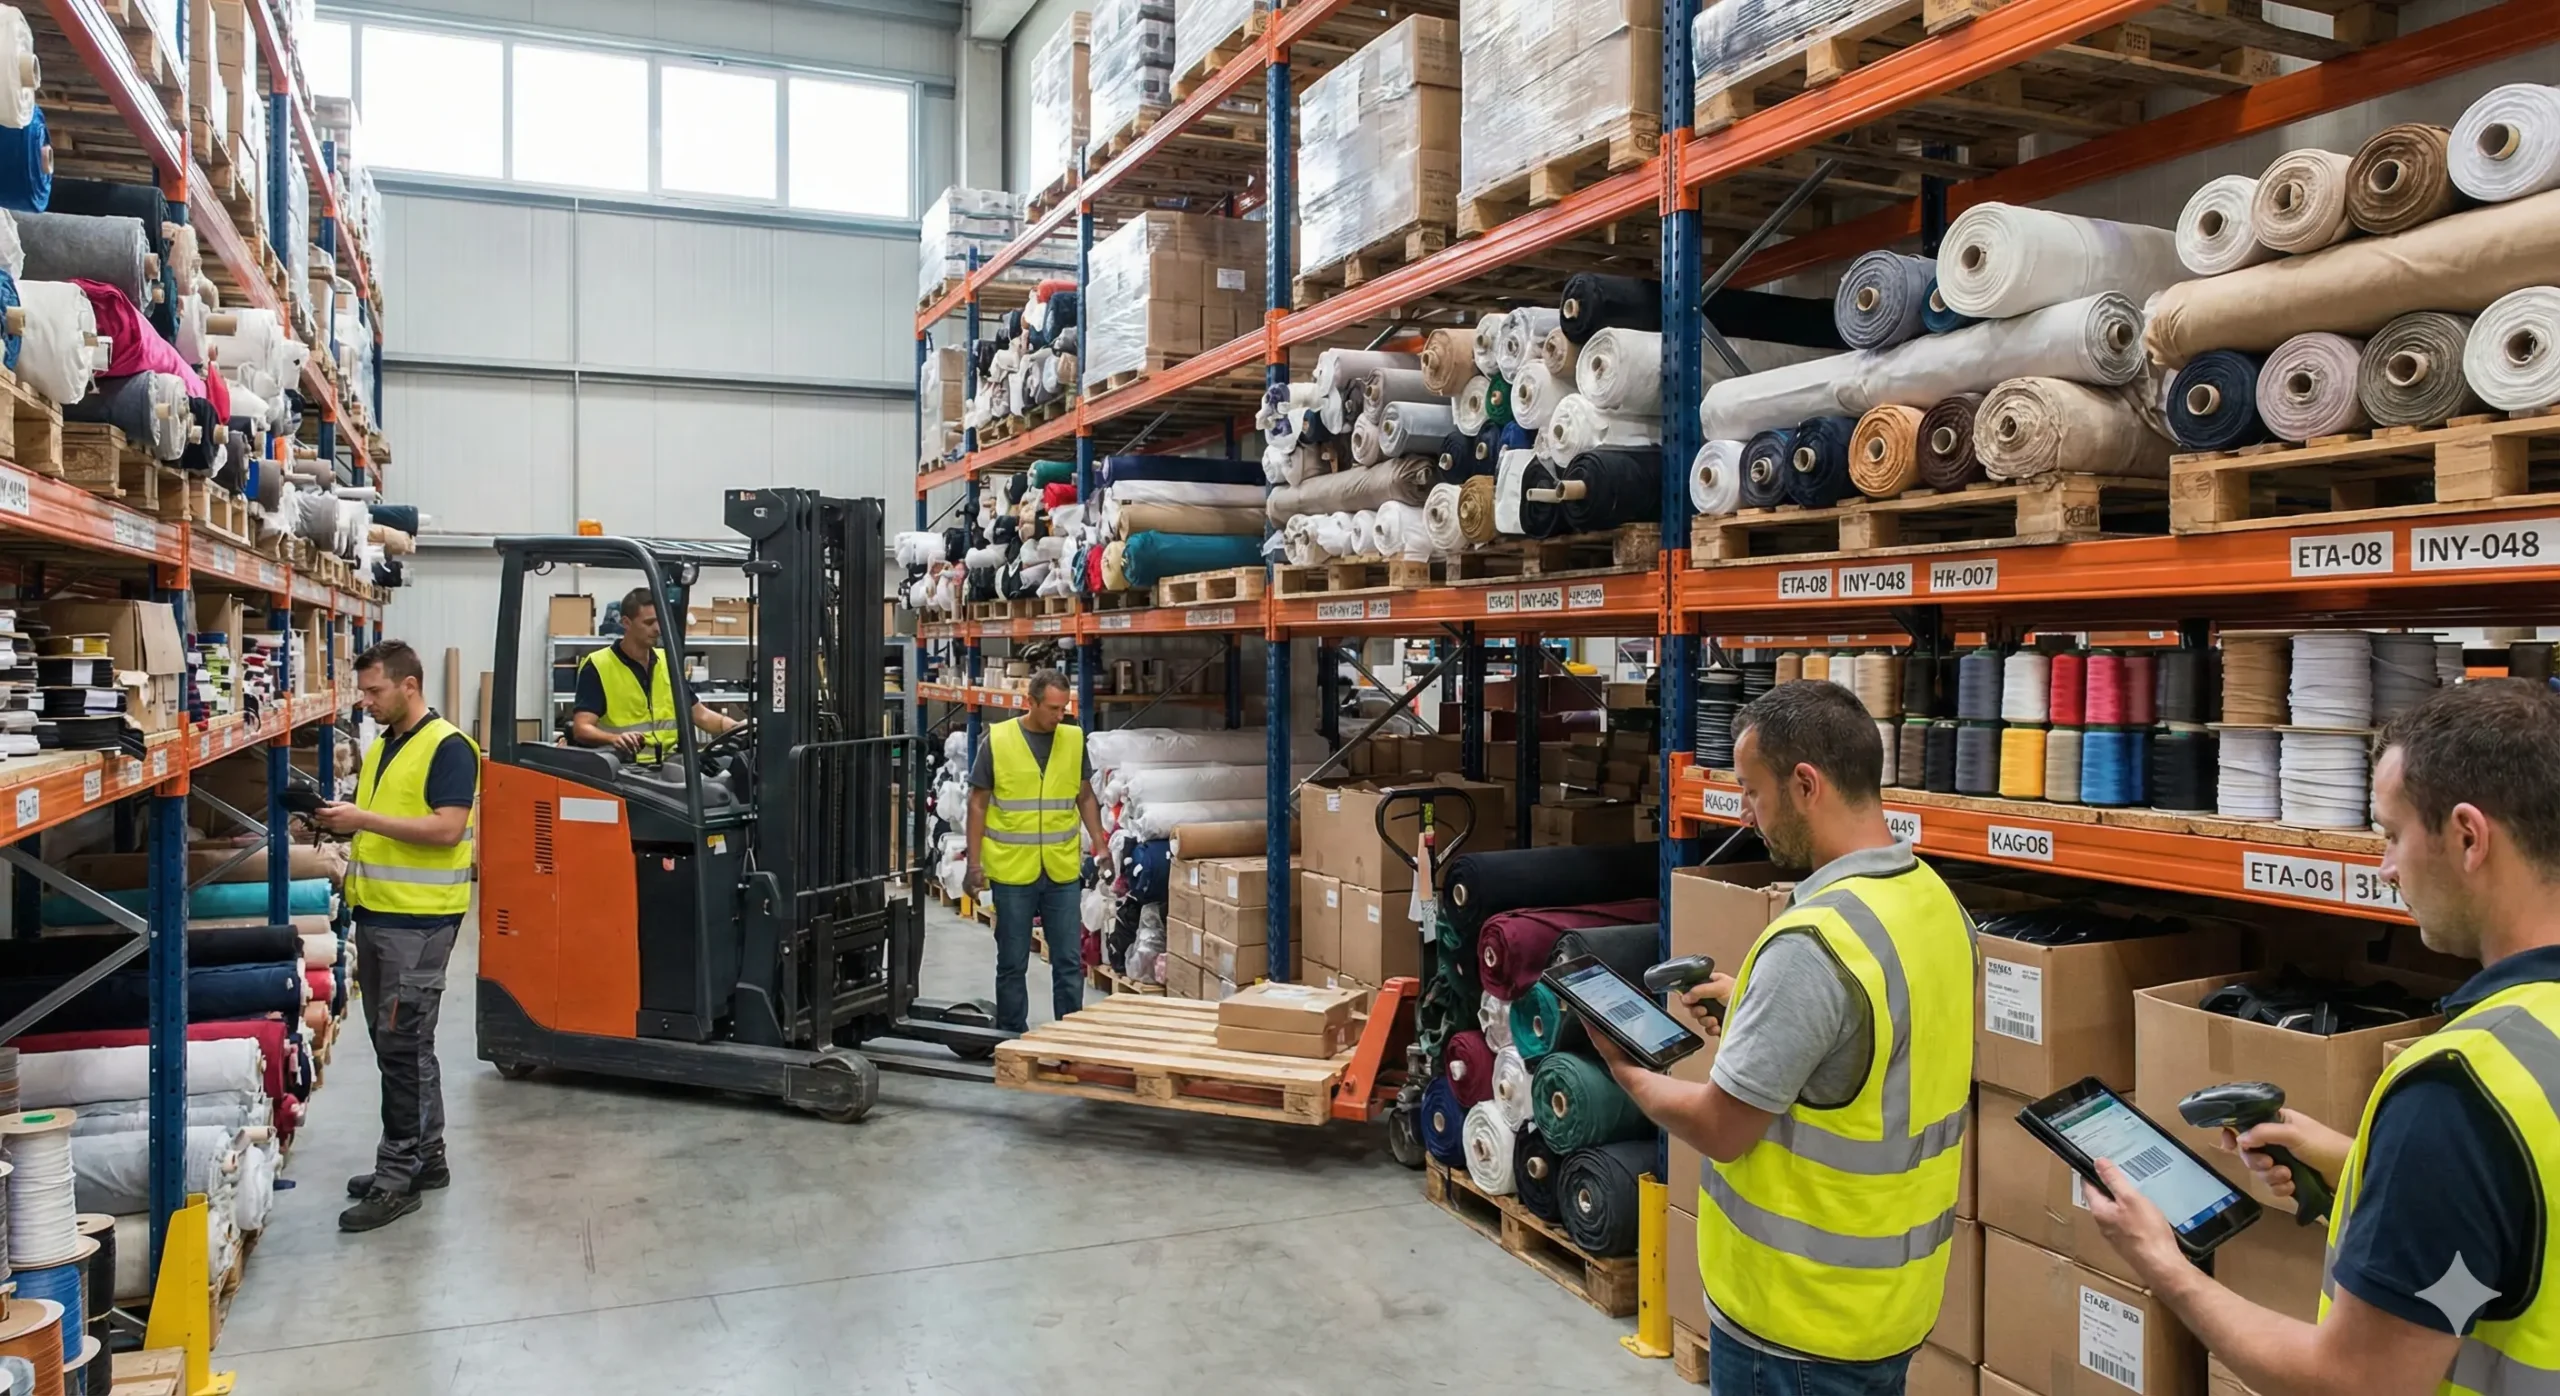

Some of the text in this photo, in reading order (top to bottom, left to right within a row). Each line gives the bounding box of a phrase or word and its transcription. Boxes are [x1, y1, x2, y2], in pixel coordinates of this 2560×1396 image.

[2298, 541, 2383, 568] ETA-08
[2419, 531, 2541, 562] INY-048
[1782, 575, 1827, 593] ETA-08
[1843, 571, 1906, 592] INY-048
[1992, 832, 2048, 855] KAG-06
